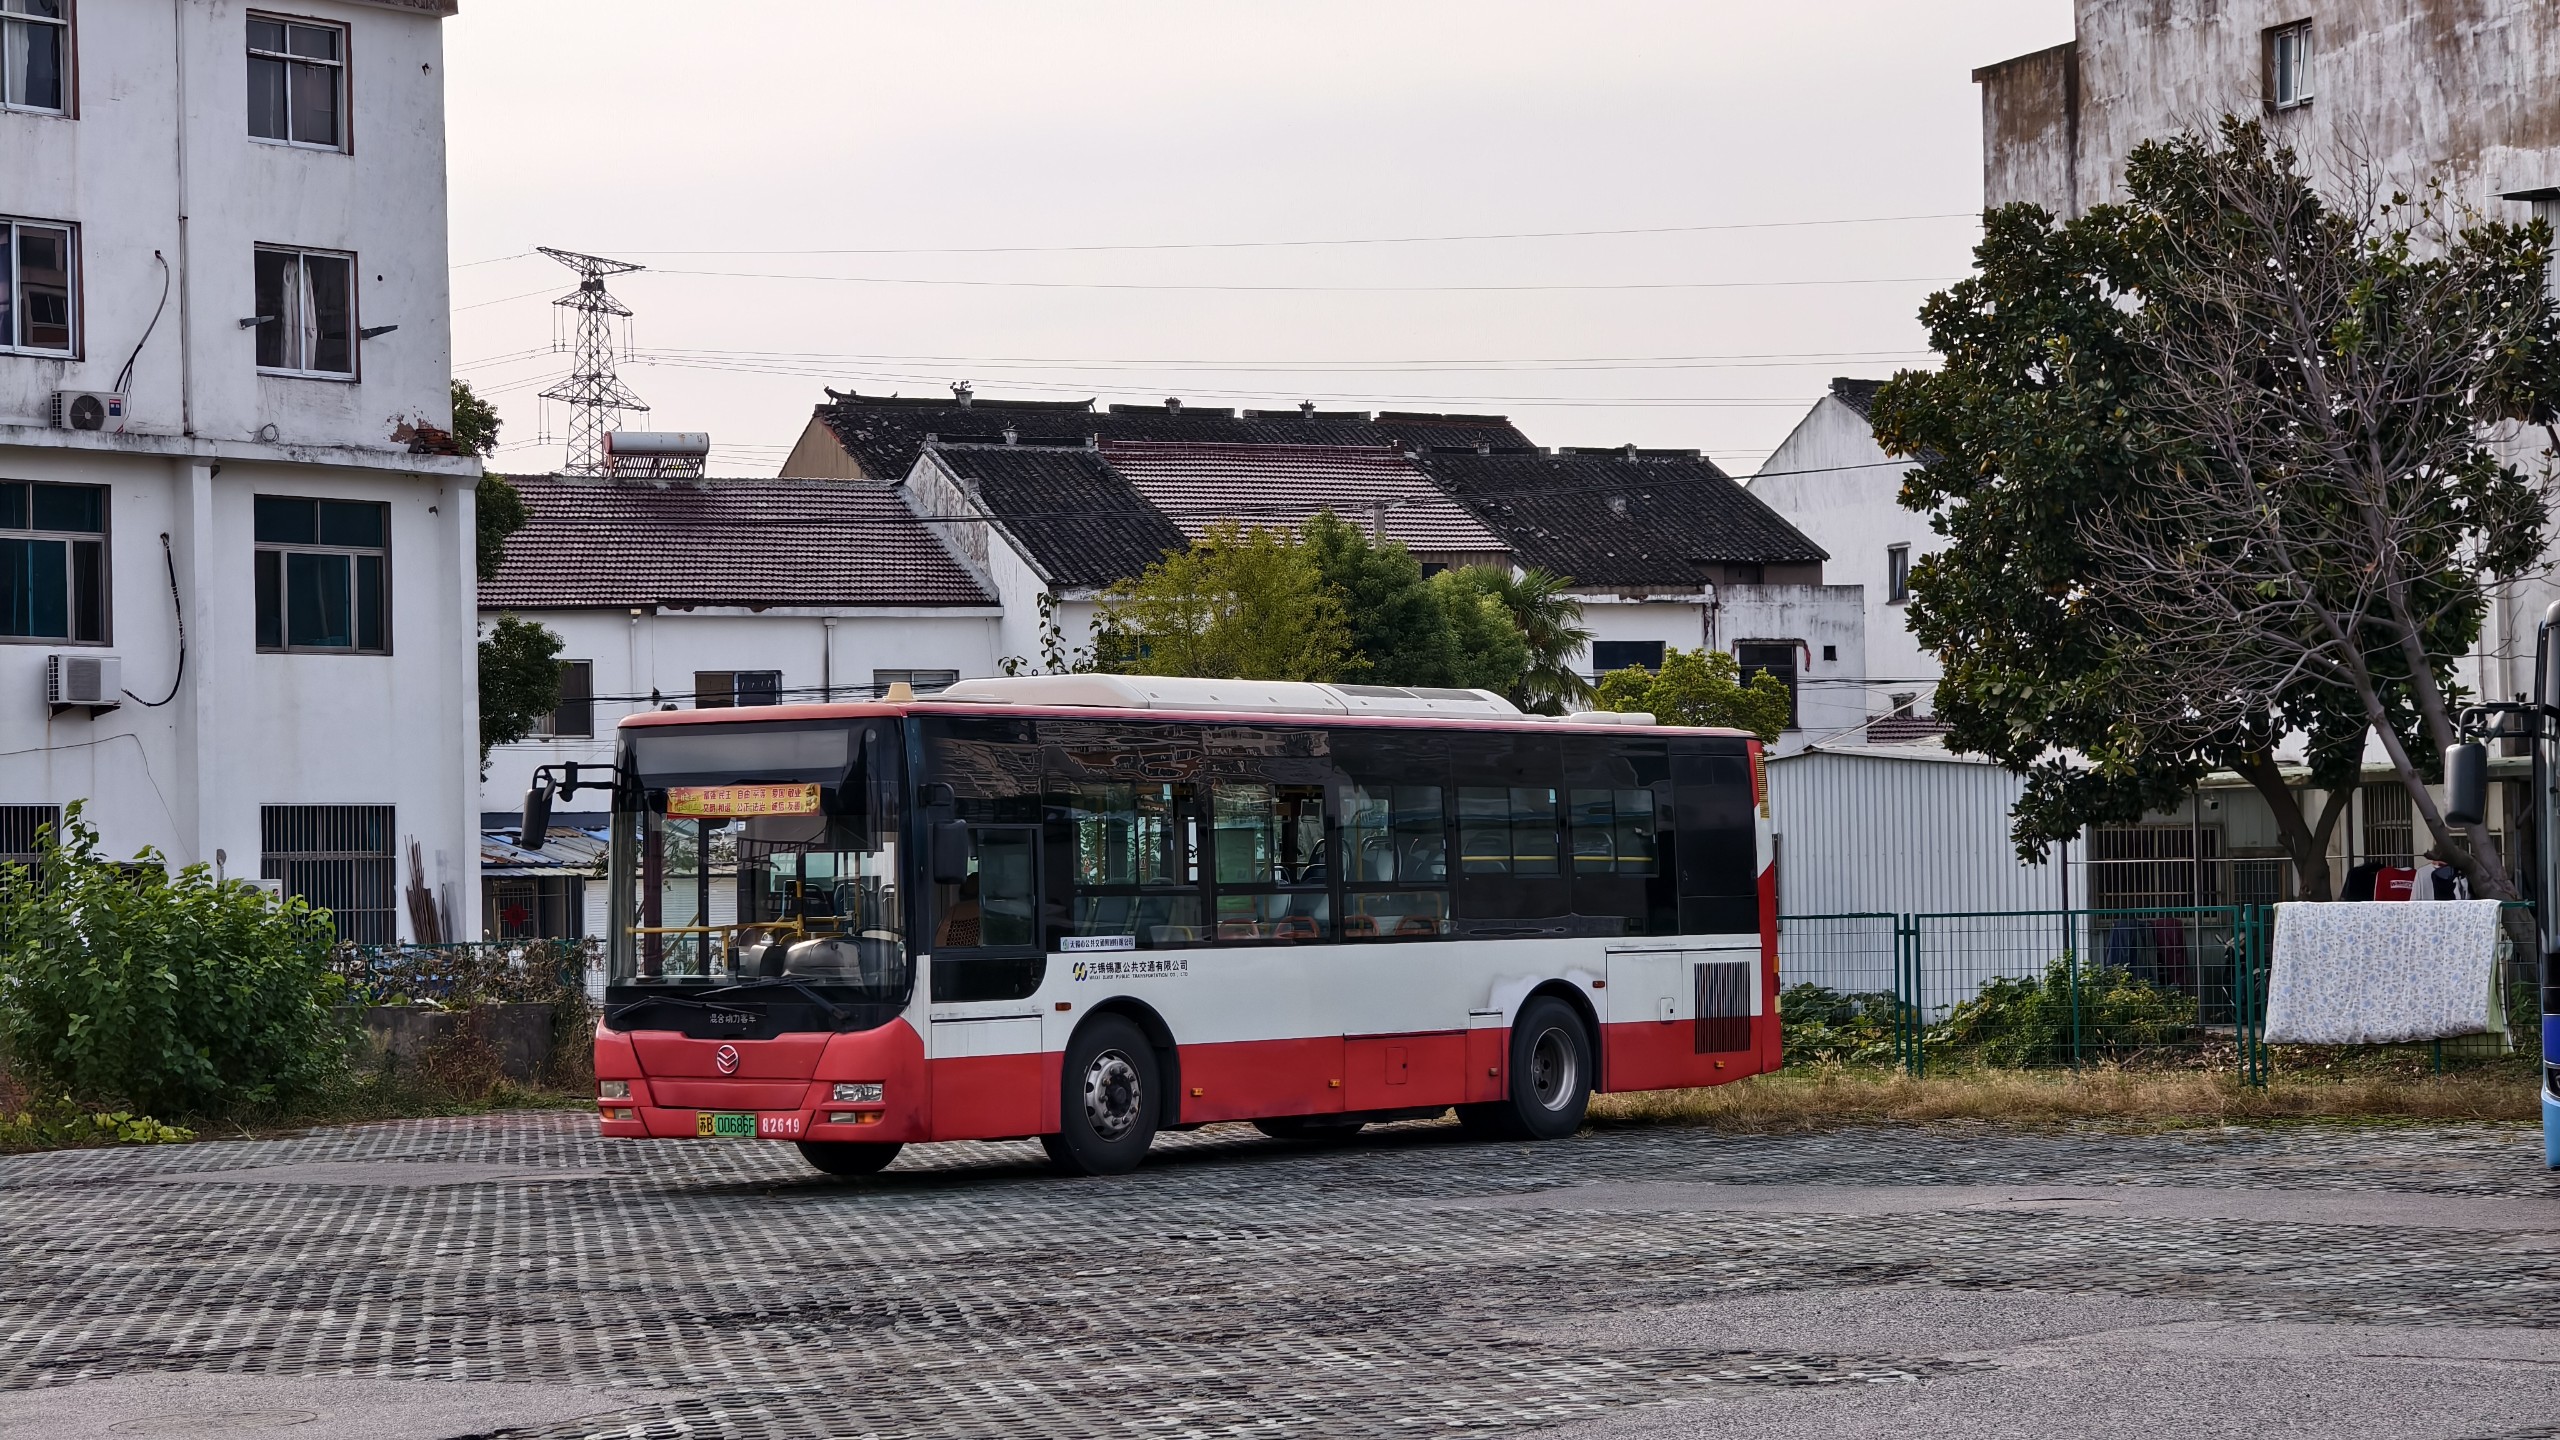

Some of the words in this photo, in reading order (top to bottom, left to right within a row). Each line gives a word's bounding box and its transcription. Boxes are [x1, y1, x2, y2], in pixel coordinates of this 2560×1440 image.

[1089, 960, 1188, 974] 无锡锡惠公共交通有限公司
[710, 1013, 757, 1023] 混合动力客车
[762, 1118, 800, 1133] 82619
